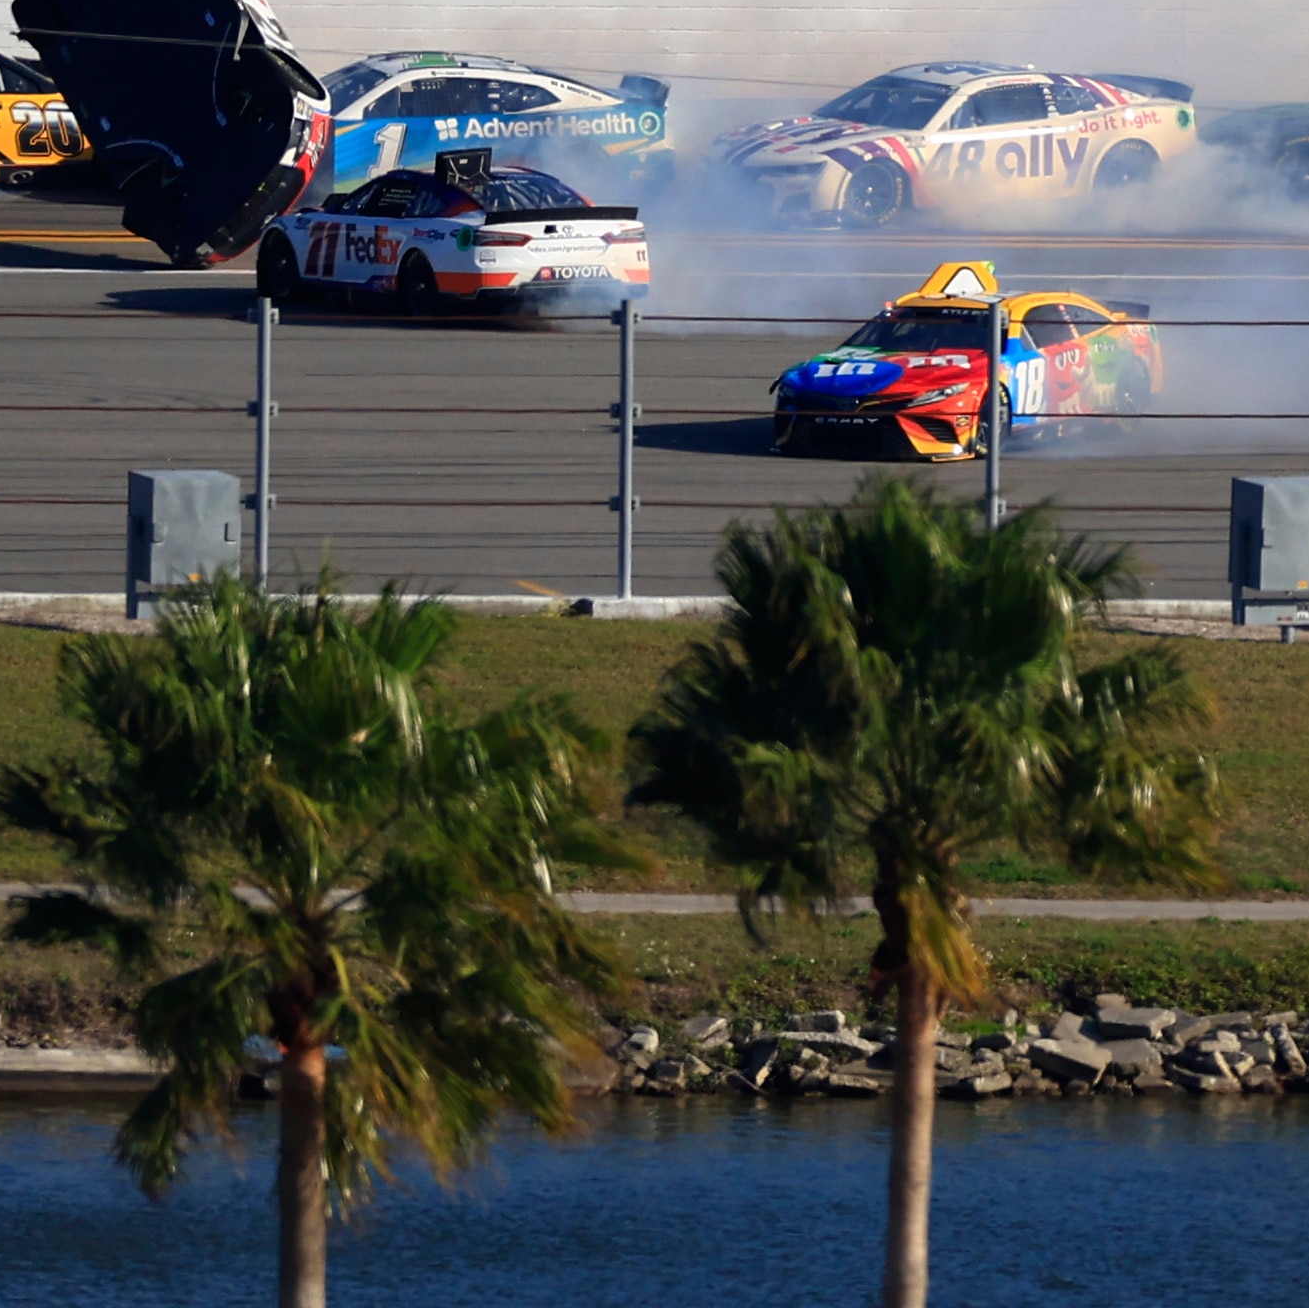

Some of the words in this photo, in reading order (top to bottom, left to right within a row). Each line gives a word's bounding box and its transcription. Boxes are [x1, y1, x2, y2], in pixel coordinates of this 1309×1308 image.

[9, 100, 84, 158] 20
[1104, 115, 1118, 131] it
[366, 123, 407, 180] 1
[925, 139, 986, 179] 48
[996, 126, 1090, 189] ally
[304, 221, 342, 277] 11
[345, 223, 403, 265] FedEx
[636, 249, 647, 262] 11
[552, 266, 609, 279] TOYOTA
[1015, 358, 1046, 414] 18
